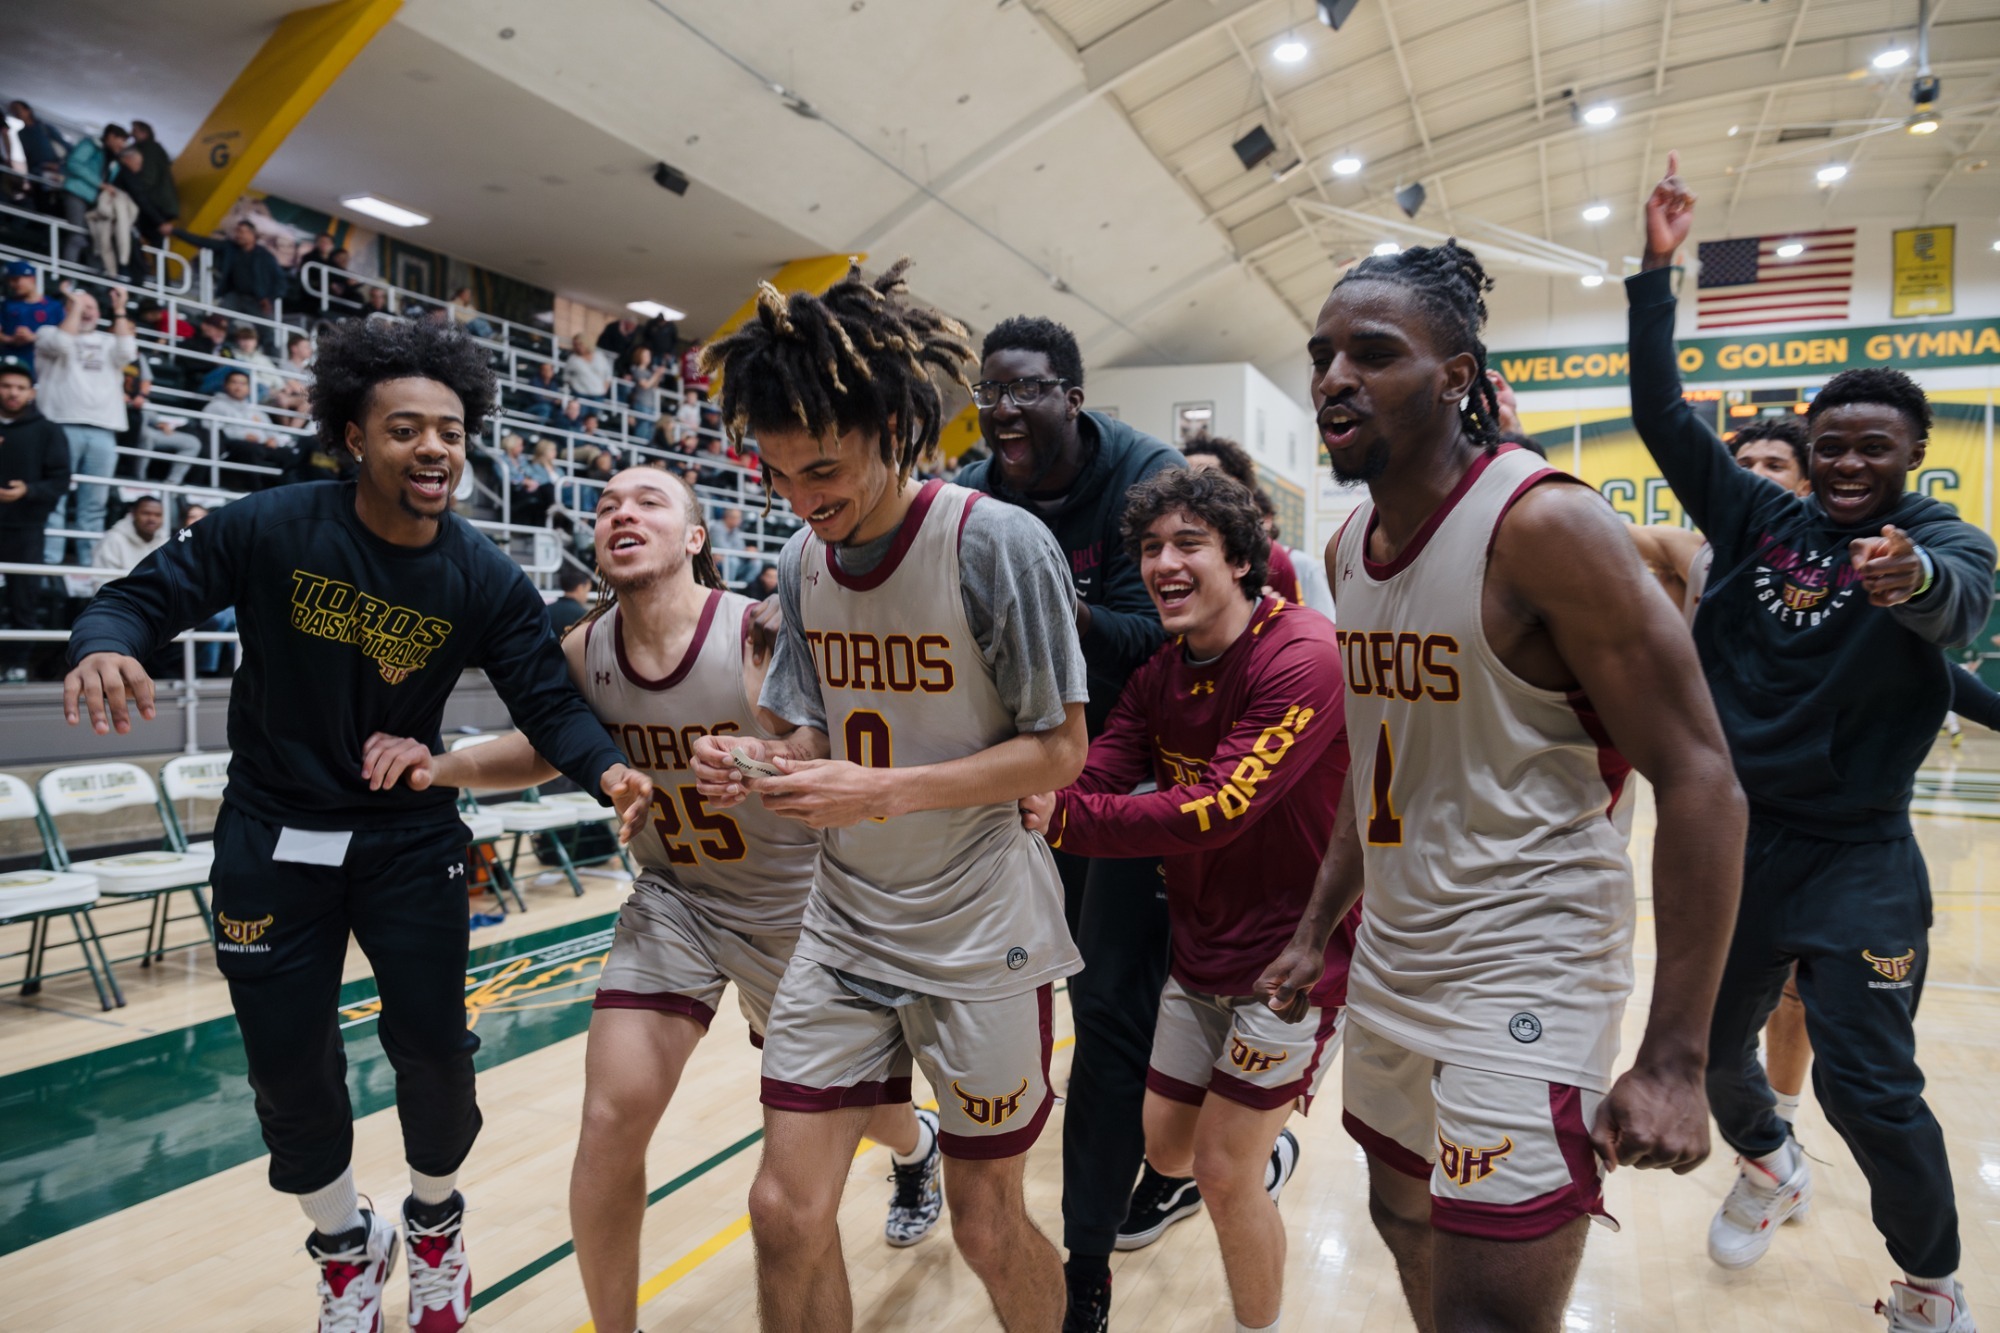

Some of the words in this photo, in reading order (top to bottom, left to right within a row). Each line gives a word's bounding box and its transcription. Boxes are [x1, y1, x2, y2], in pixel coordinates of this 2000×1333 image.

[210, 143, 230, 170] G
[1501, 352, 1630, 383] WELCOM
[1677, 347, 1704, 373] O
[1716, 337, 1848, 370] GOLDEN
[290, 603, 432, 669] BASKETBALL
[292, 569, 453, 649] TOROS
[1179, 704, 1315, 832] TOROS
[1368, 719, 1403, 847] 1
[650, 784, 748, 866] 25
[218, 942, 272, 953] BASKETBALL
[1231, 1036, 1288, 1072] DH
[951, 1077, 1029, 1128] DH
[1438, 1125, 1514, 1188] DH
